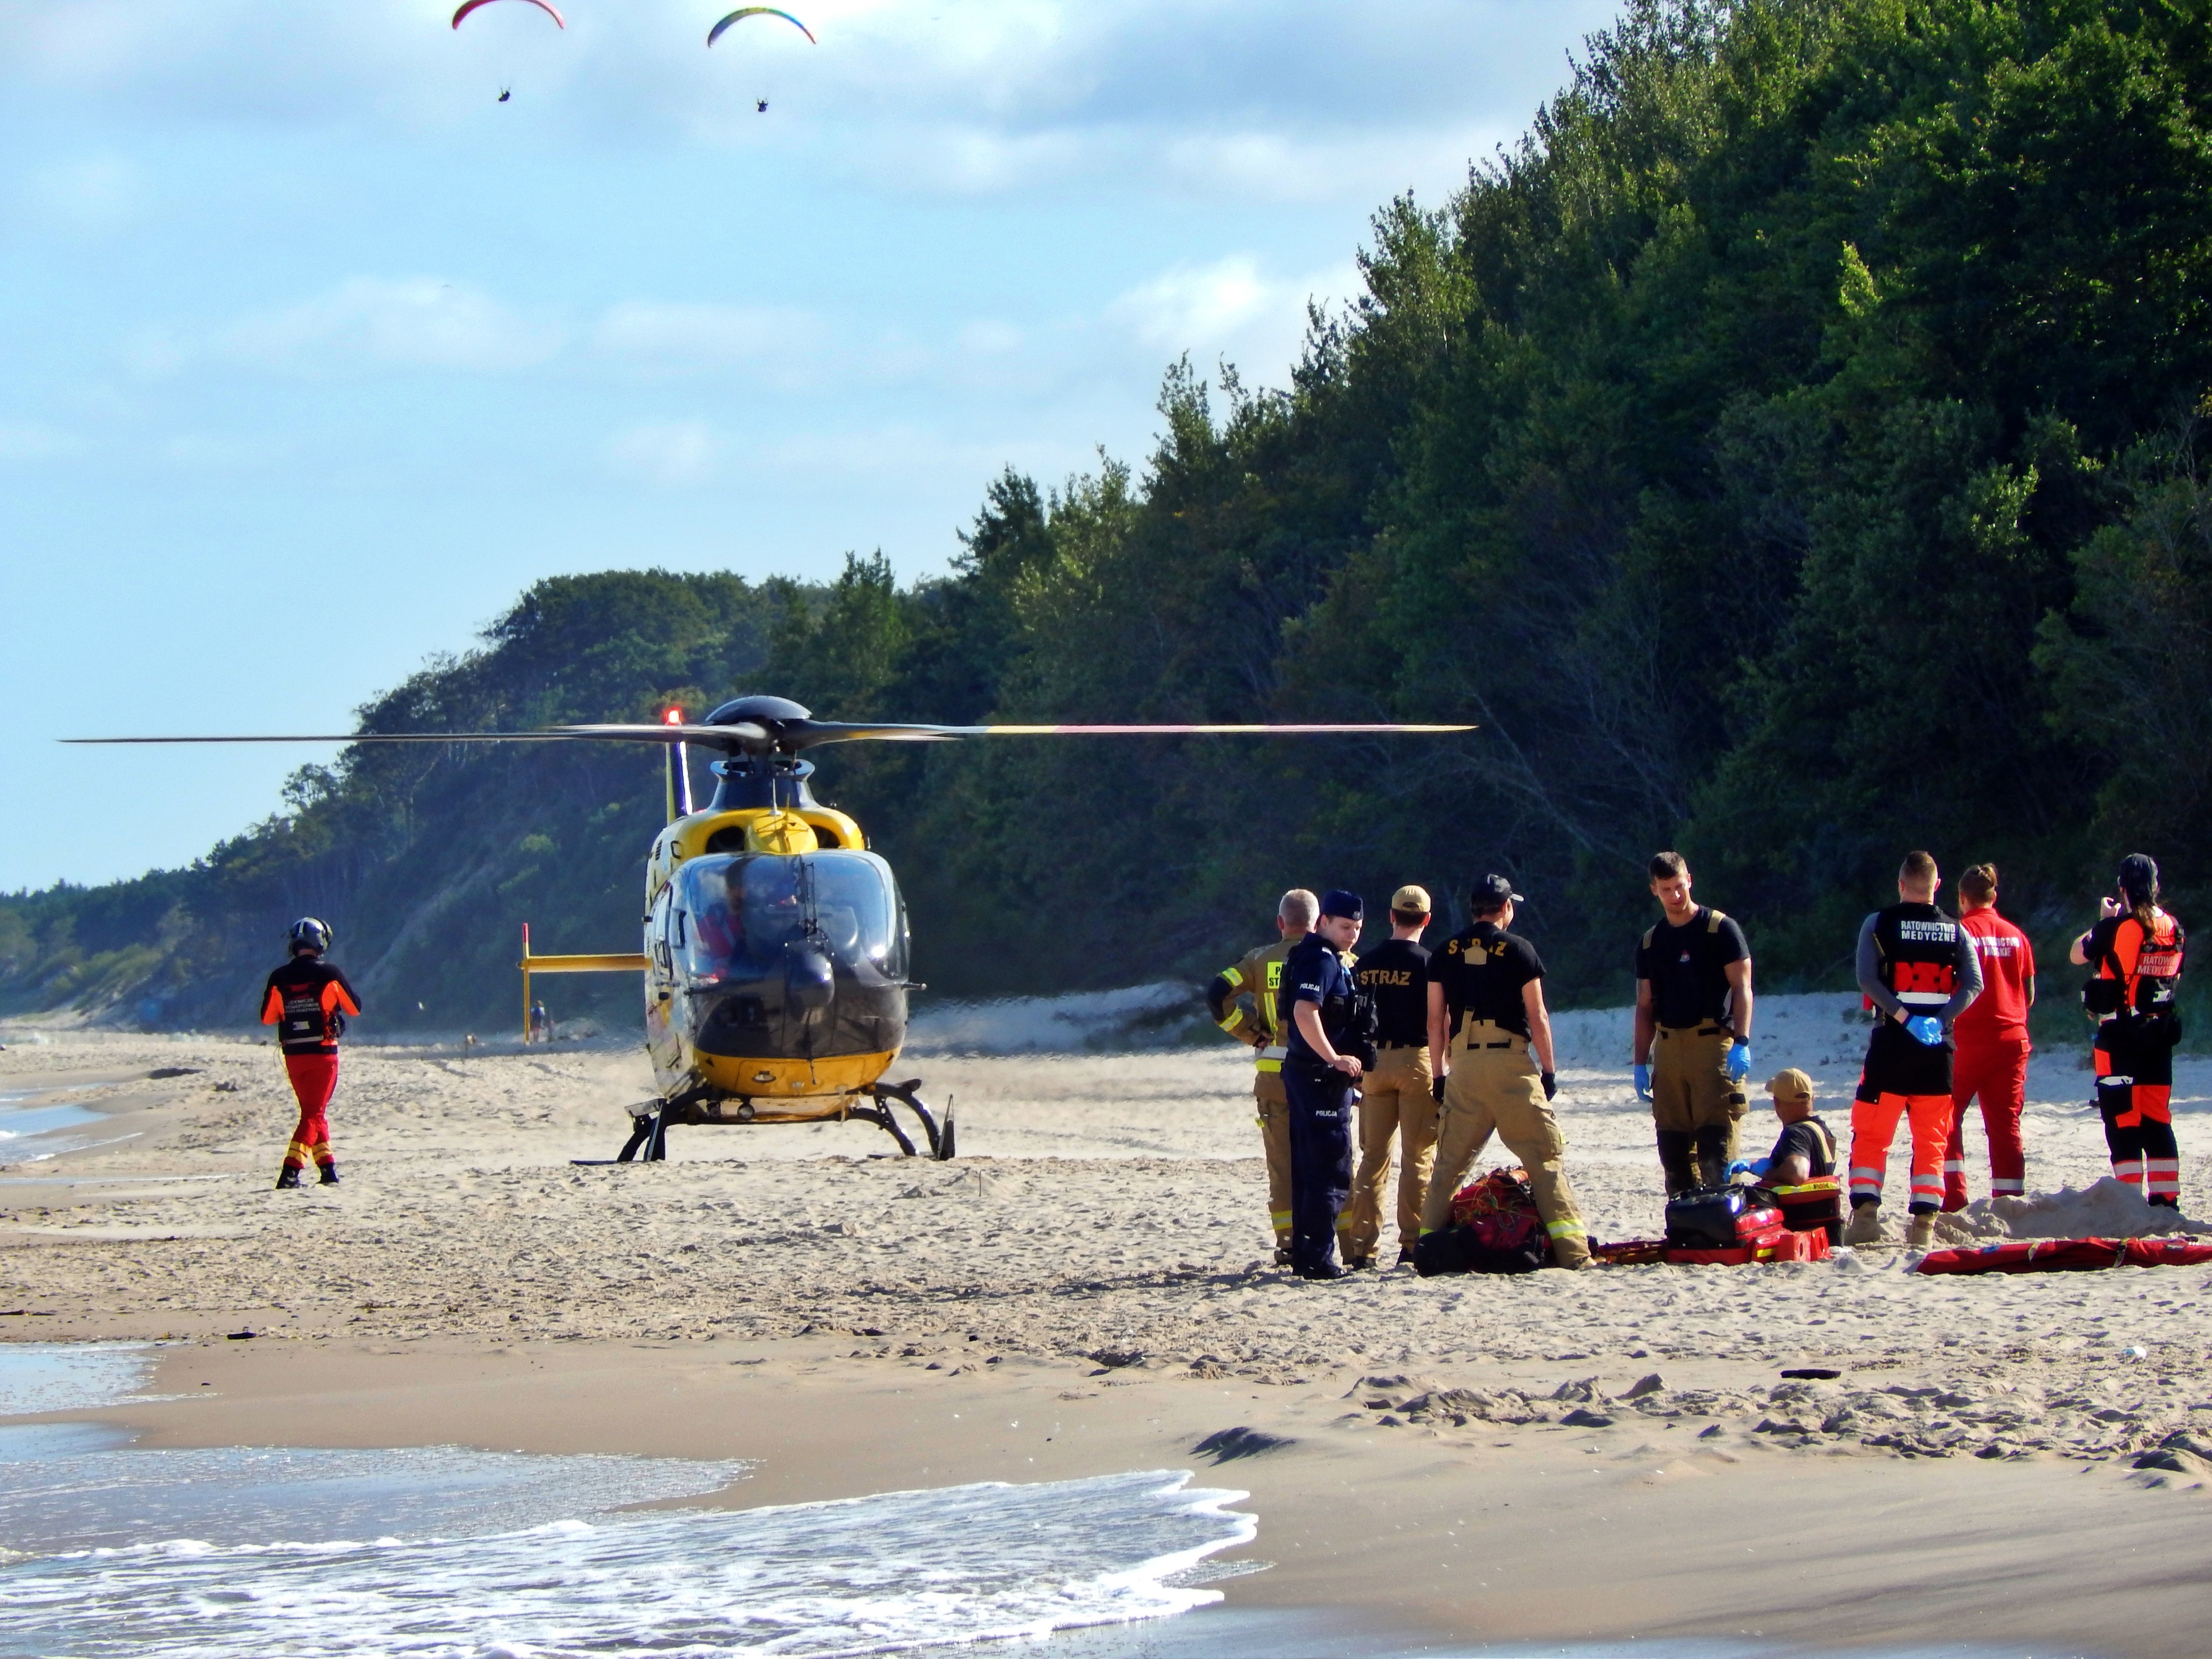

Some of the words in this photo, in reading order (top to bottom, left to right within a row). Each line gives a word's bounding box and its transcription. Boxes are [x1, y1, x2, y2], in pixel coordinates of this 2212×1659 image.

[1901, 920, 1956, 933] RATOWNICTWO
[1901, 930, 1956, 942] MEDYCZNE
[1360, 970, 1411, 985] STRAZ
[1299, 983, 1320, 992] POLICJA
